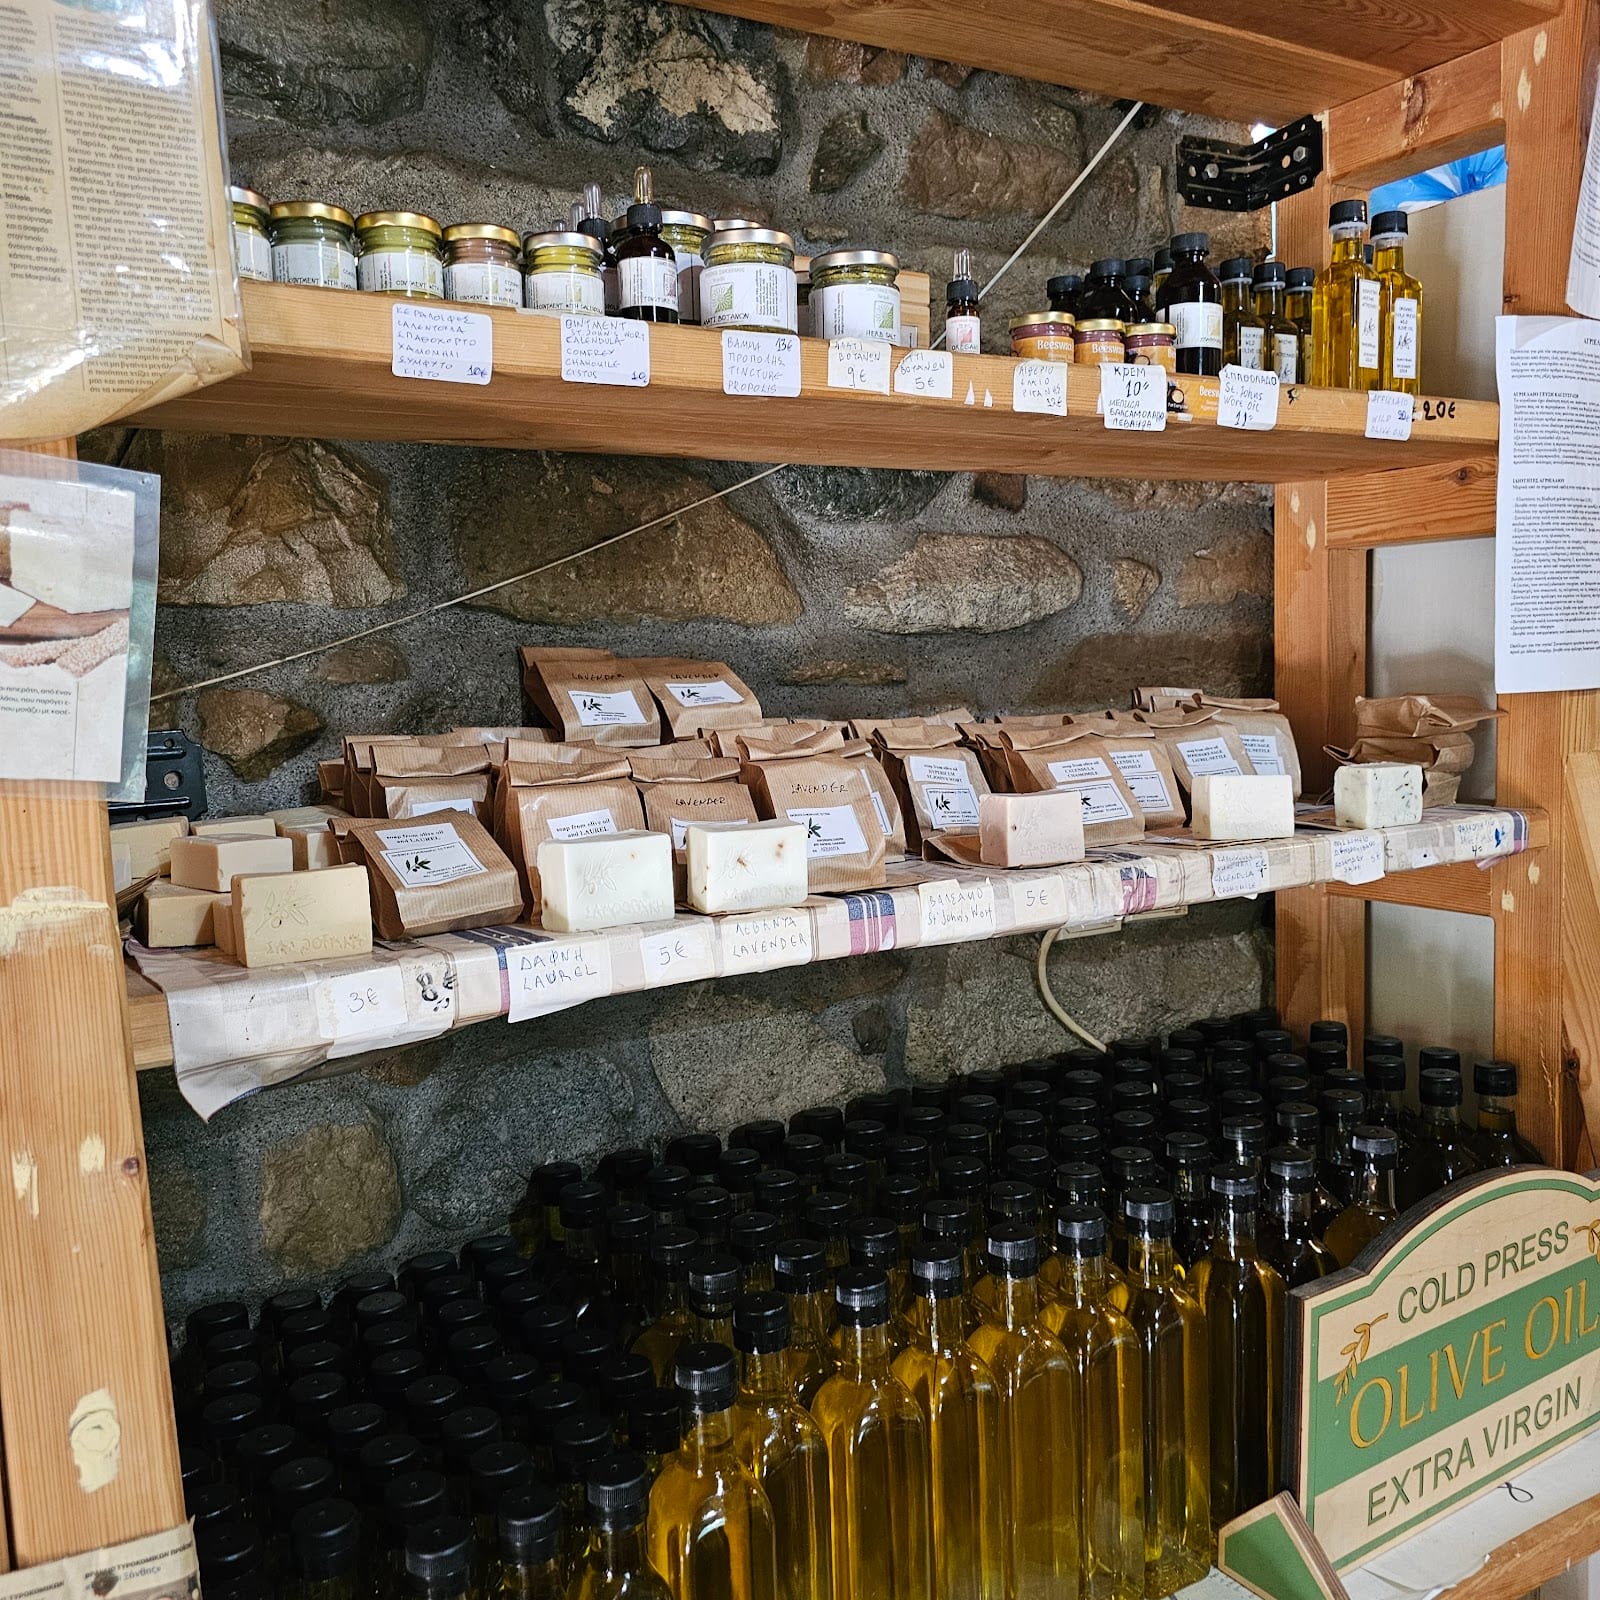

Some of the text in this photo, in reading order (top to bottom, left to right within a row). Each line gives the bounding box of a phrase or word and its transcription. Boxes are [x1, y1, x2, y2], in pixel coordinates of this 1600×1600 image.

[728, 380, 777, 394] PROPOLIS
[791, 781, 848, 794] LAVENDER
[675, 796, 726, 806] LAVENDER
[971, 905, 994, 924] Wort
[733, 932, 807, 958] LAVENDER
[523, 964, 598, 991] LAUREL
[1396, 1220, 1569, 1324] COLD PRESS
[1348, 1278, 1600, 1449] OLIVE OIL
[1367, 1376, 1582, 1526] EXTRA VIRGIN
